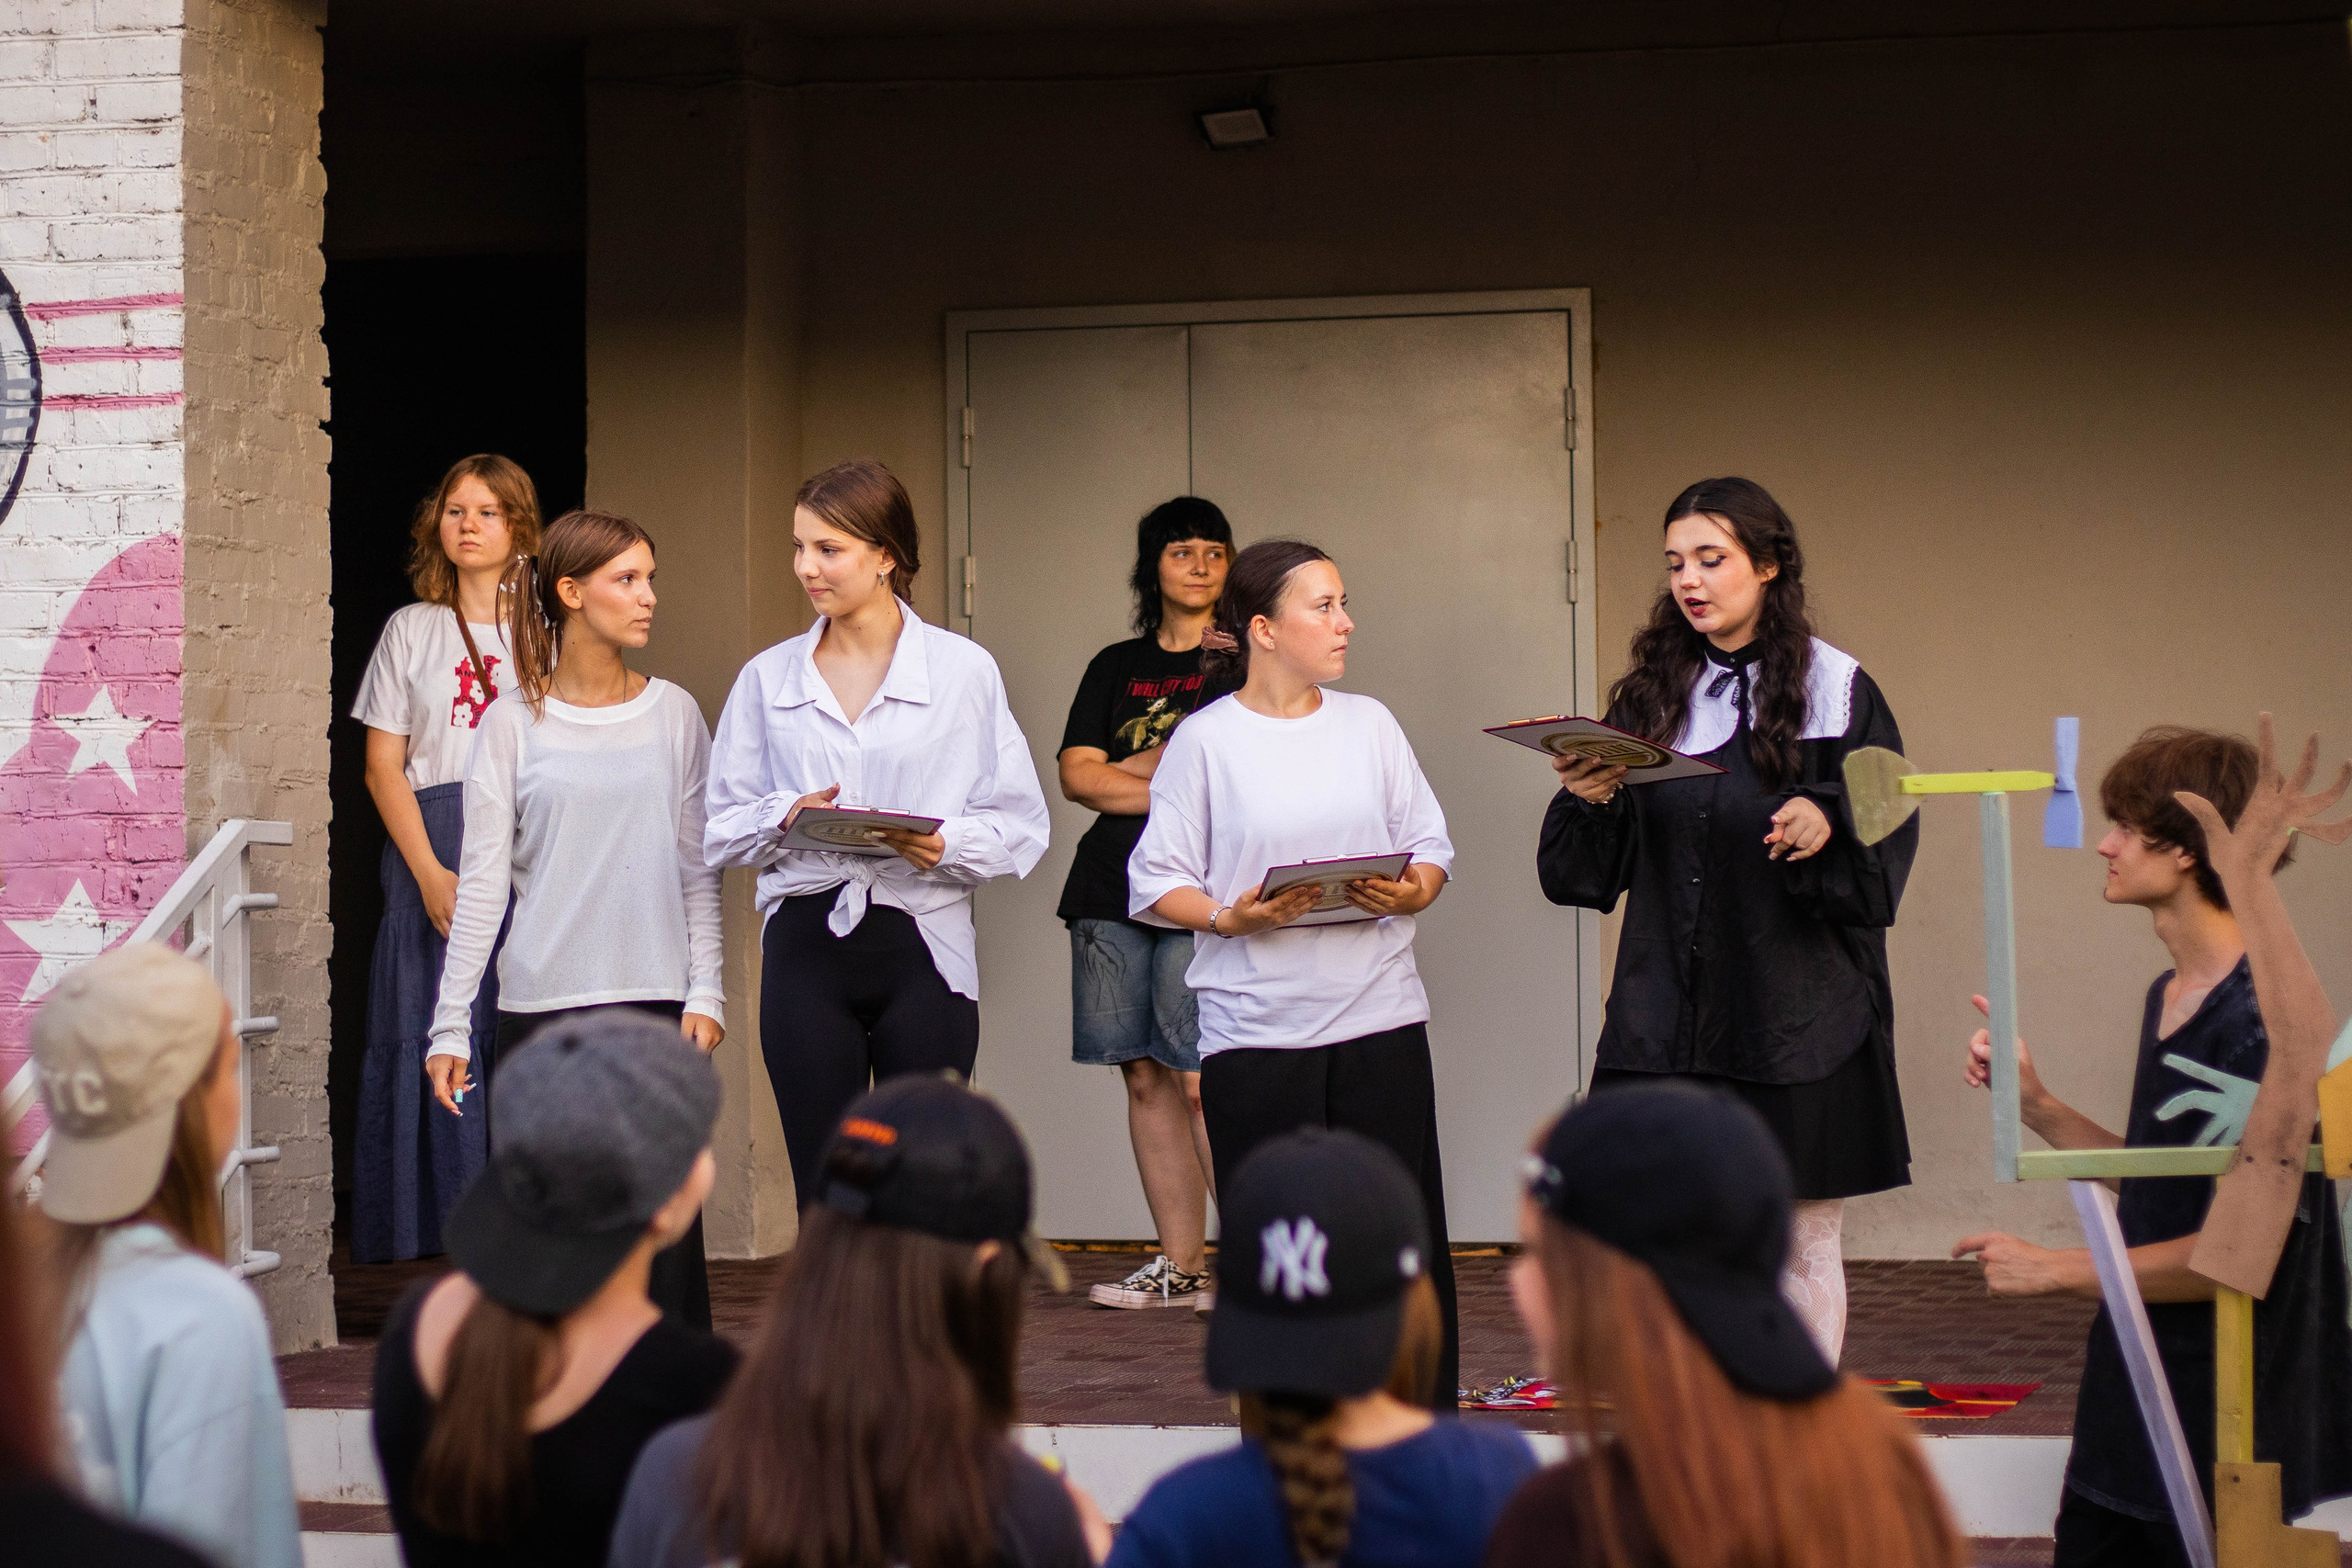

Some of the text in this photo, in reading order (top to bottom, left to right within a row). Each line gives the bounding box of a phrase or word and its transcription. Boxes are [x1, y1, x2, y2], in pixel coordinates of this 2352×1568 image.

[1132, 682, 1159, 697] WILL
[454, 695, 481, 727] POSSIBLE
[1259, 1214, 1330, 1303] NY
